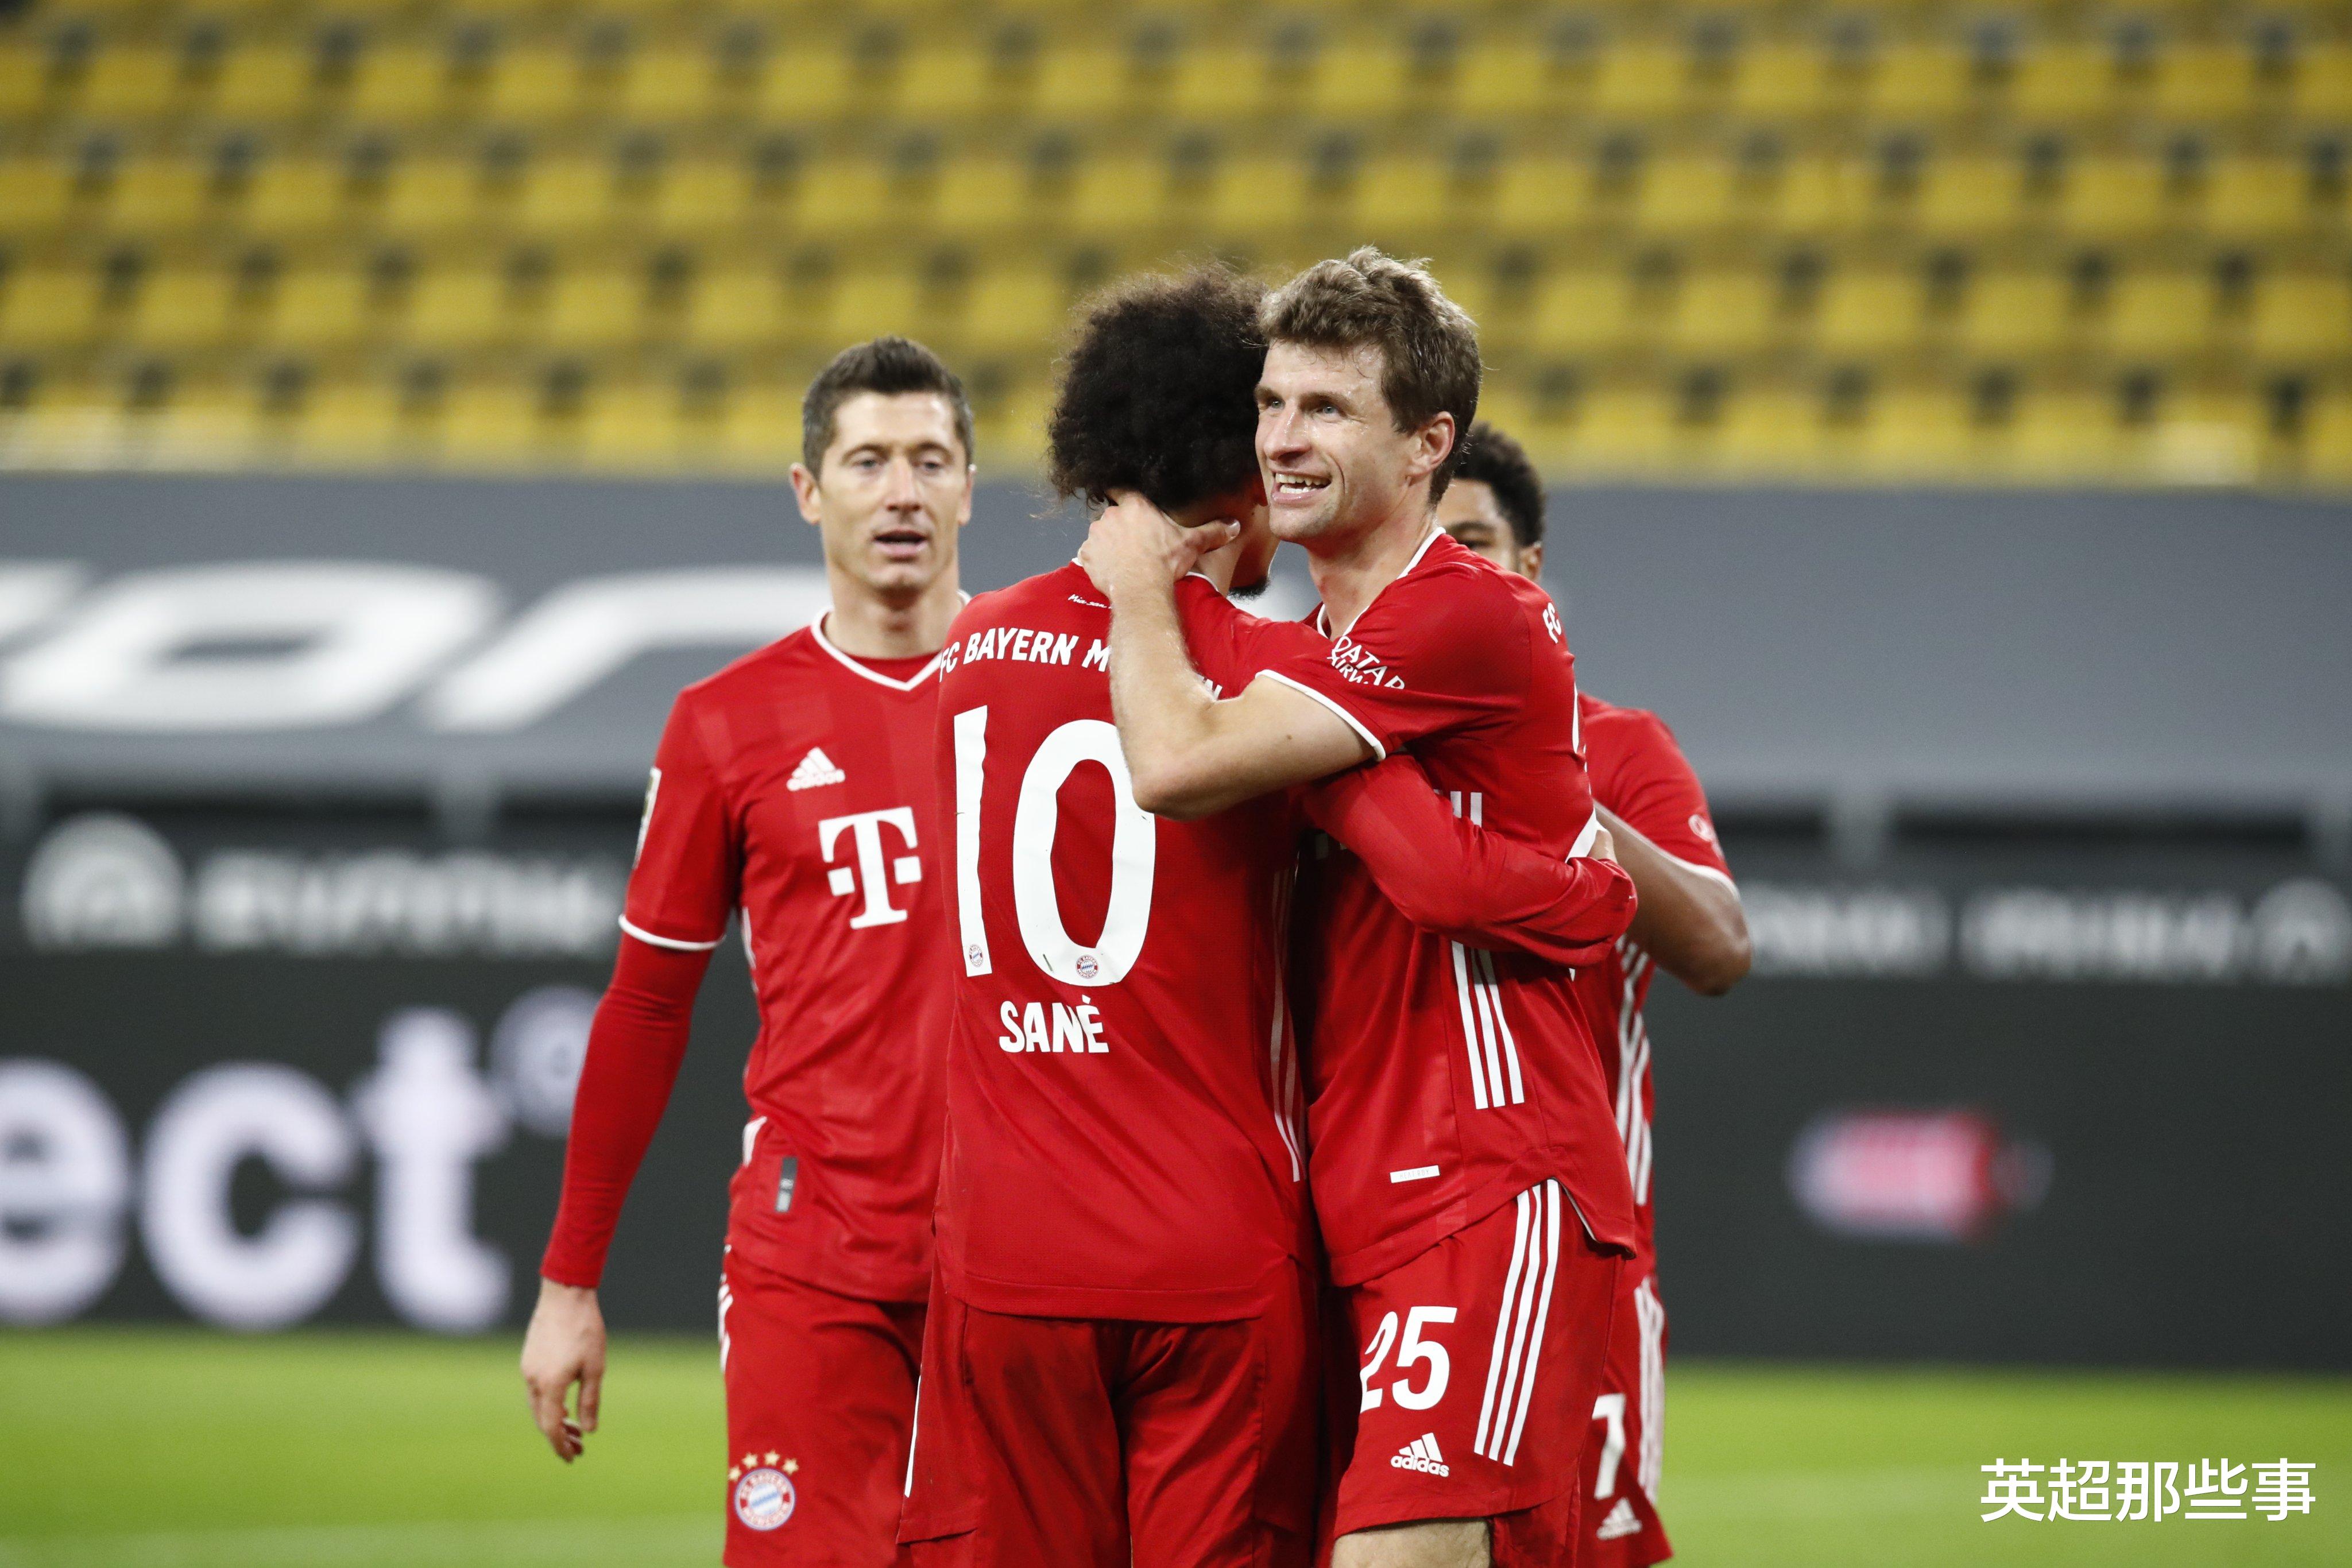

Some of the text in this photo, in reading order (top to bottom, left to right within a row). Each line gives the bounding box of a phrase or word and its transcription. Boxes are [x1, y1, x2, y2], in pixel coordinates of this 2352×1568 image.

[963, 628, 1079, 666] BAYERN
[1543, 602, 1562, 644] FC
[954, 705, 1156, 987] 10
[1360, 1306, 1457, 1414] 25
[1390, 1454, 1450, 1478] adidas
[1592, 1393, 1626, 1501] 7
